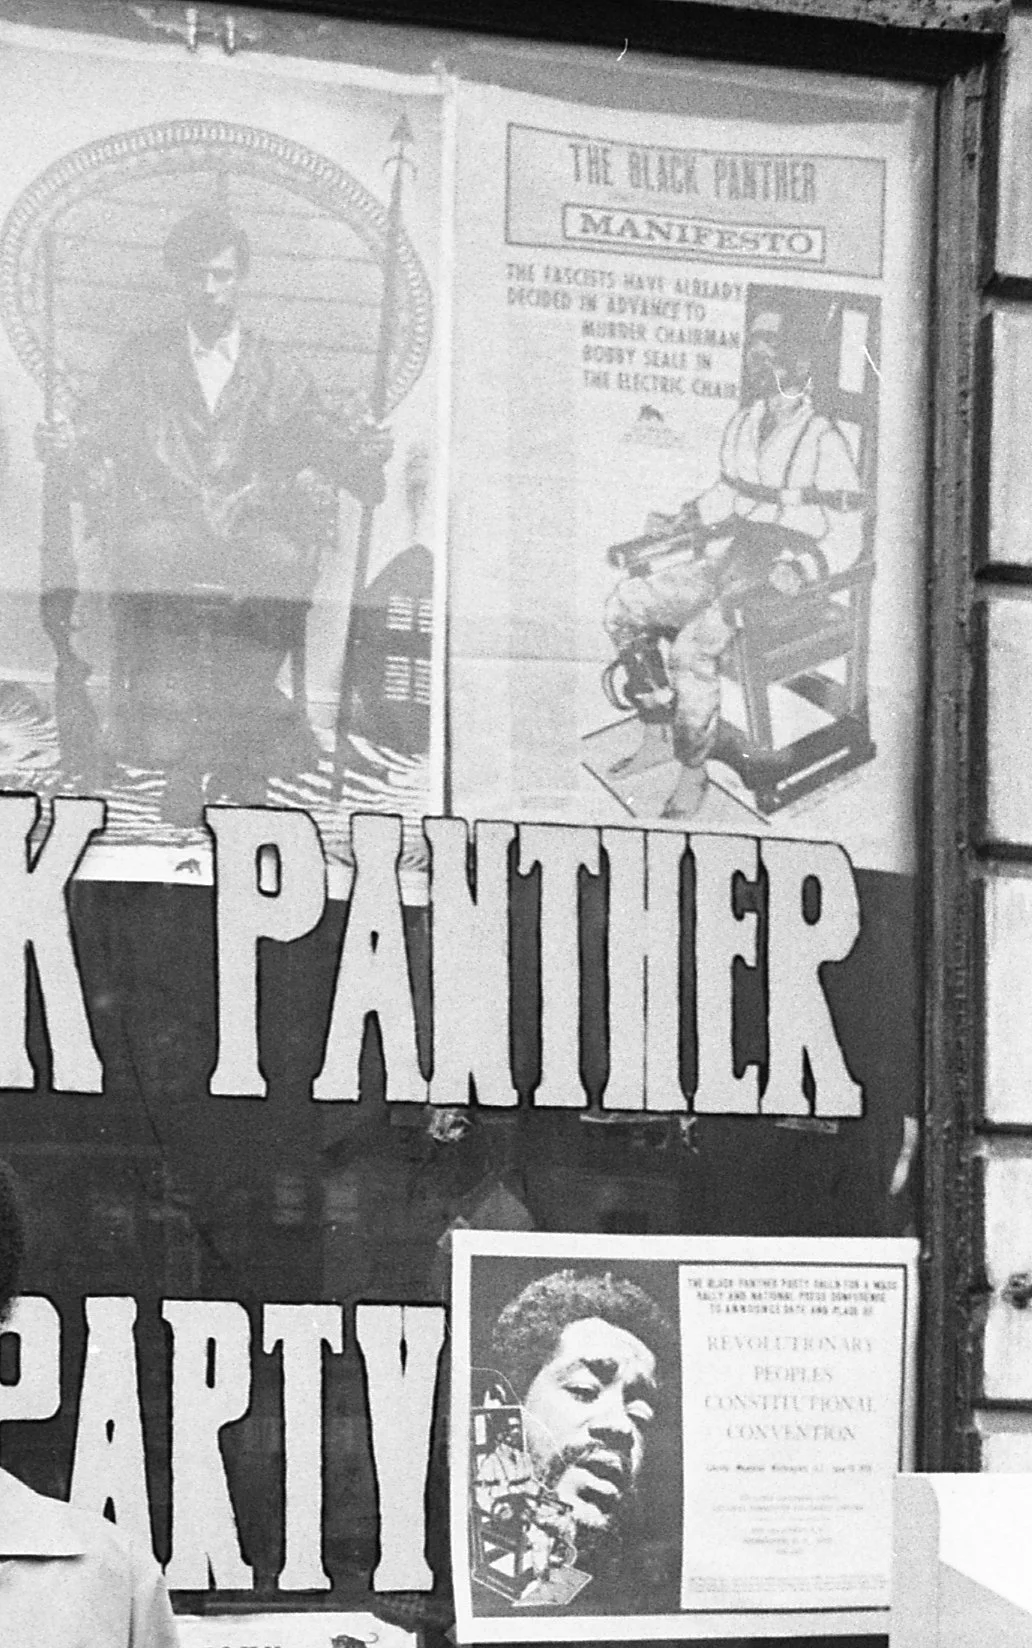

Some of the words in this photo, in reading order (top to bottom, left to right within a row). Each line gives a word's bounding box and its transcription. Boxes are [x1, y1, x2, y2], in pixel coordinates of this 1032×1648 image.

[569, 143, 614, 186] THE
[627, 149, 699, 194] BLACK
[714, 156, 816, 204] PANTHER
[580, 212, 814, 254] MANIFESTO
[506, 262, 536, 283] THE
[543, 264, 616, 289] FASCISTS
[624, 273, 665, 292] HAVE
[674, 277, 745, 301] ALREADY
[506, 286, 571, 310] DECIDED
[580, 294, 597, 312] IN
[607, 295, 681, 321] ADVANCE
[684, 300, 706, 322] TO
[581, 319, 647, 341] MURDER
[655, 325, 741, 349] CHAIRMAN
[582, 344, 636, 365] BOBBY
[643, 349, 688, 370] SEALE
[696, 352, 712, 370] IN
[583, 369, 610, 390] THE
[617, 371, 686, 396] ELECTRIC
[691, 378, 740, 398] CHAIR
[204, 804, 865, 1118] PANTHER
[729, 1291, 746, 1301] AND
[739, 1278, 777, 1289] PANTHER
[707, 1334, 873, 1351] REVOLUTIONARY
[754, 1364, 833, 1382] PEOPLES
[705, 1394, 877, 1412] CONSTITUTIONAL
[727, 1424, 856, 1441] CONVENTION
